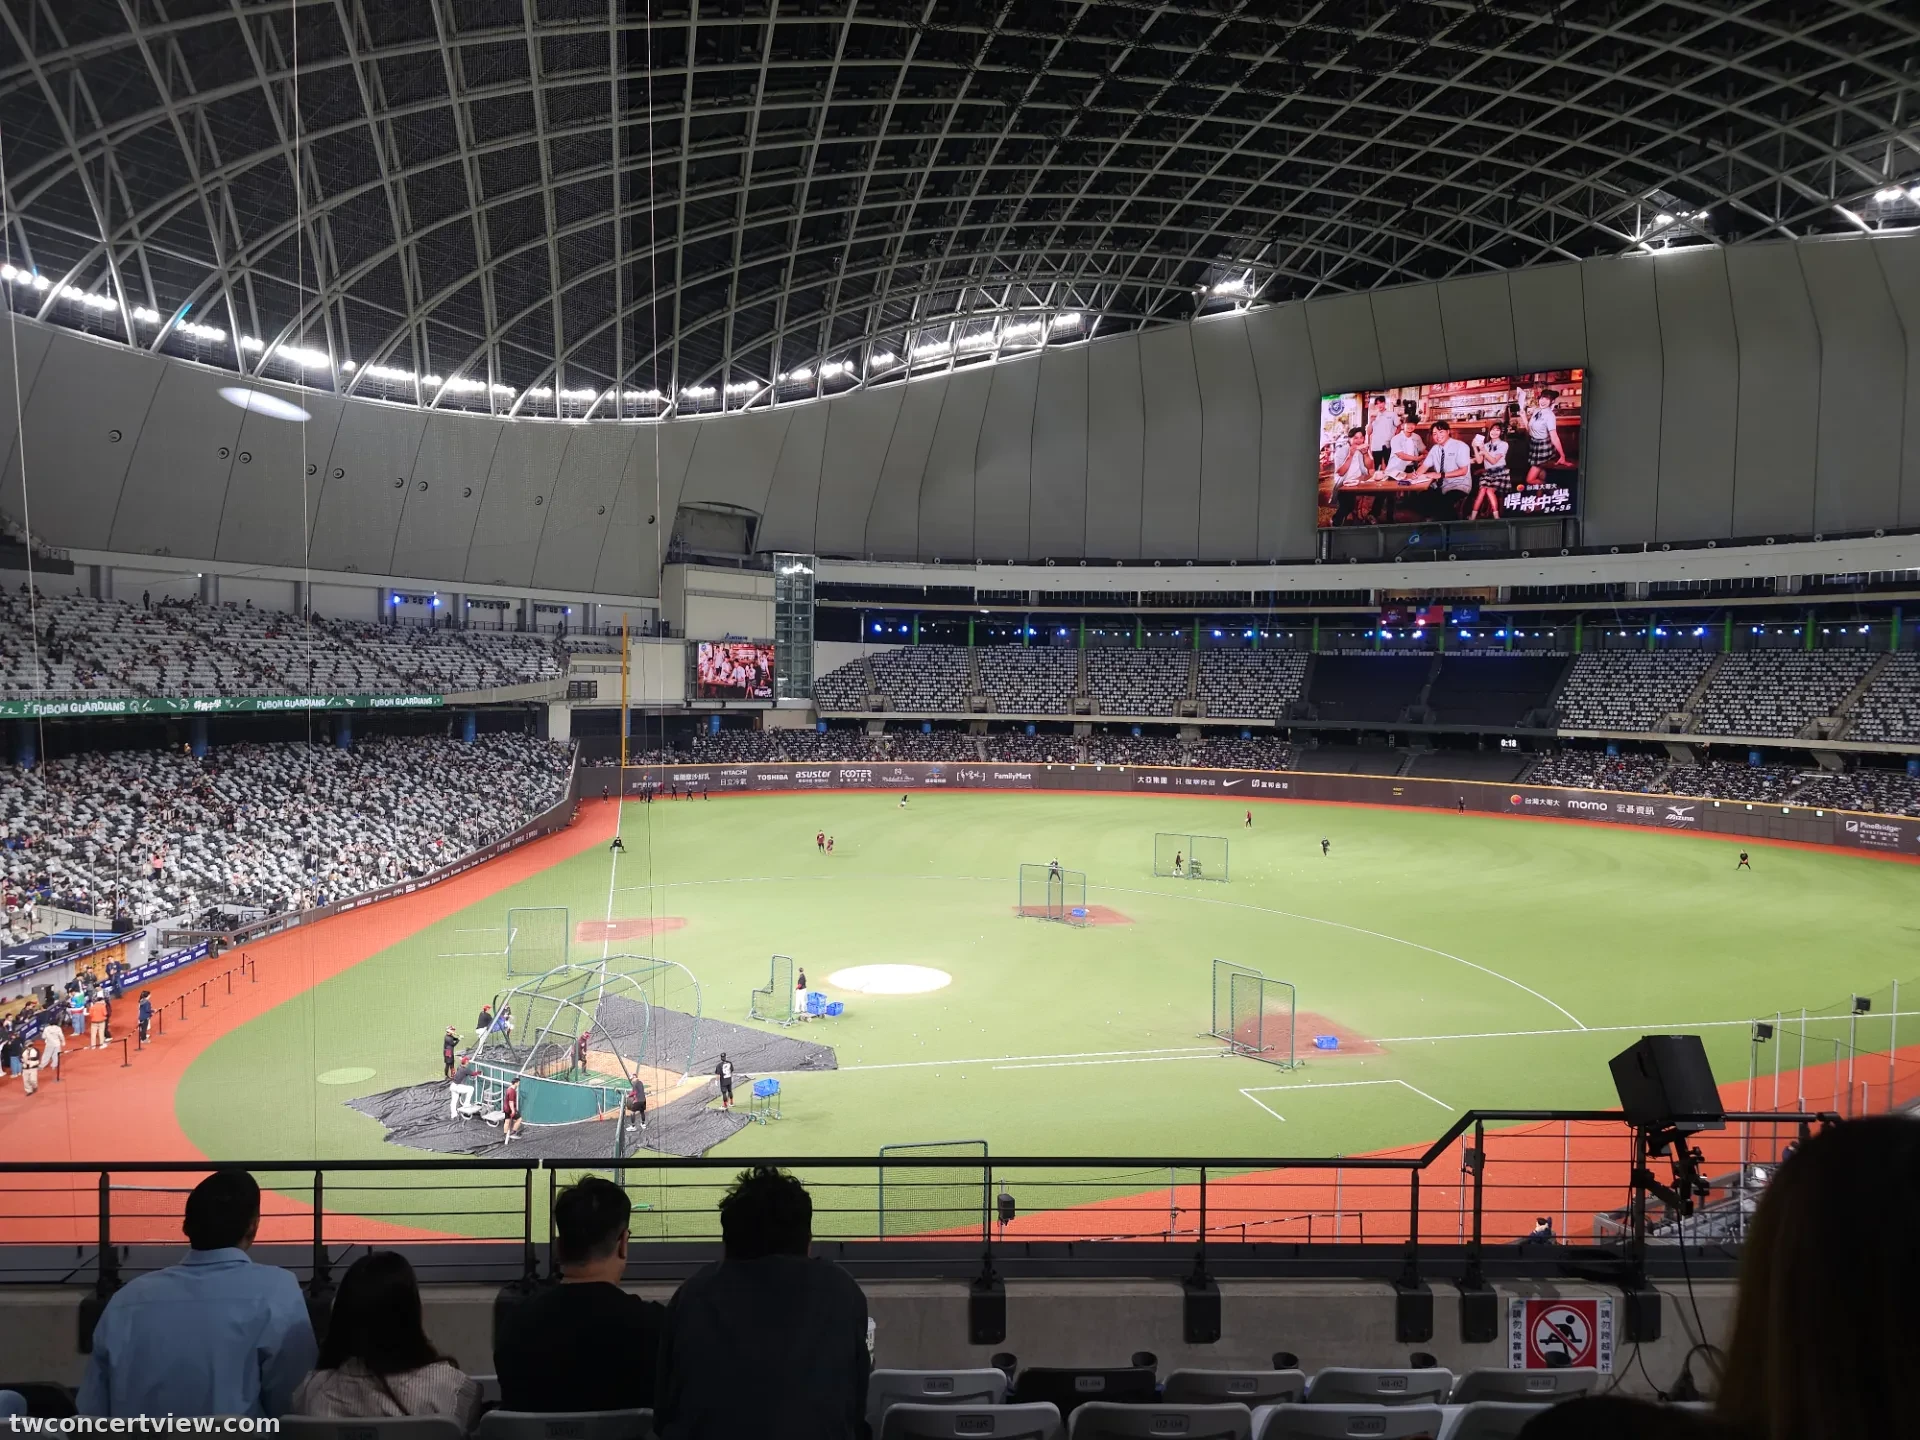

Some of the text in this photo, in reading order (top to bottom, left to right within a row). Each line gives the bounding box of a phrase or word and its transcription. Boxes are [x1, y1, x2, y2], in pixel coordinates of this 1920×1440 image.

[1503, 488, 1570, 512] 悍將中學
[256, 698, 326, 710] FUBON GUARDIANS
[370, 696, 433, 707] FUBON GUARDIANS
[33, 701, 126, 715] FUBON GUARDIANS
[1501, 739, 1517, 747] 0:18
[795, 770, 832, 779] asustor
[840, 769, 872, 778] FOOTER
[994, 772, 1032, 781] FamilyMart
[1524, 797, 1561, 807] 台灣大哥大
[1567, 800, 1608, 811] momo
[1616, 803, 1655, 816] 宏碁資訊
